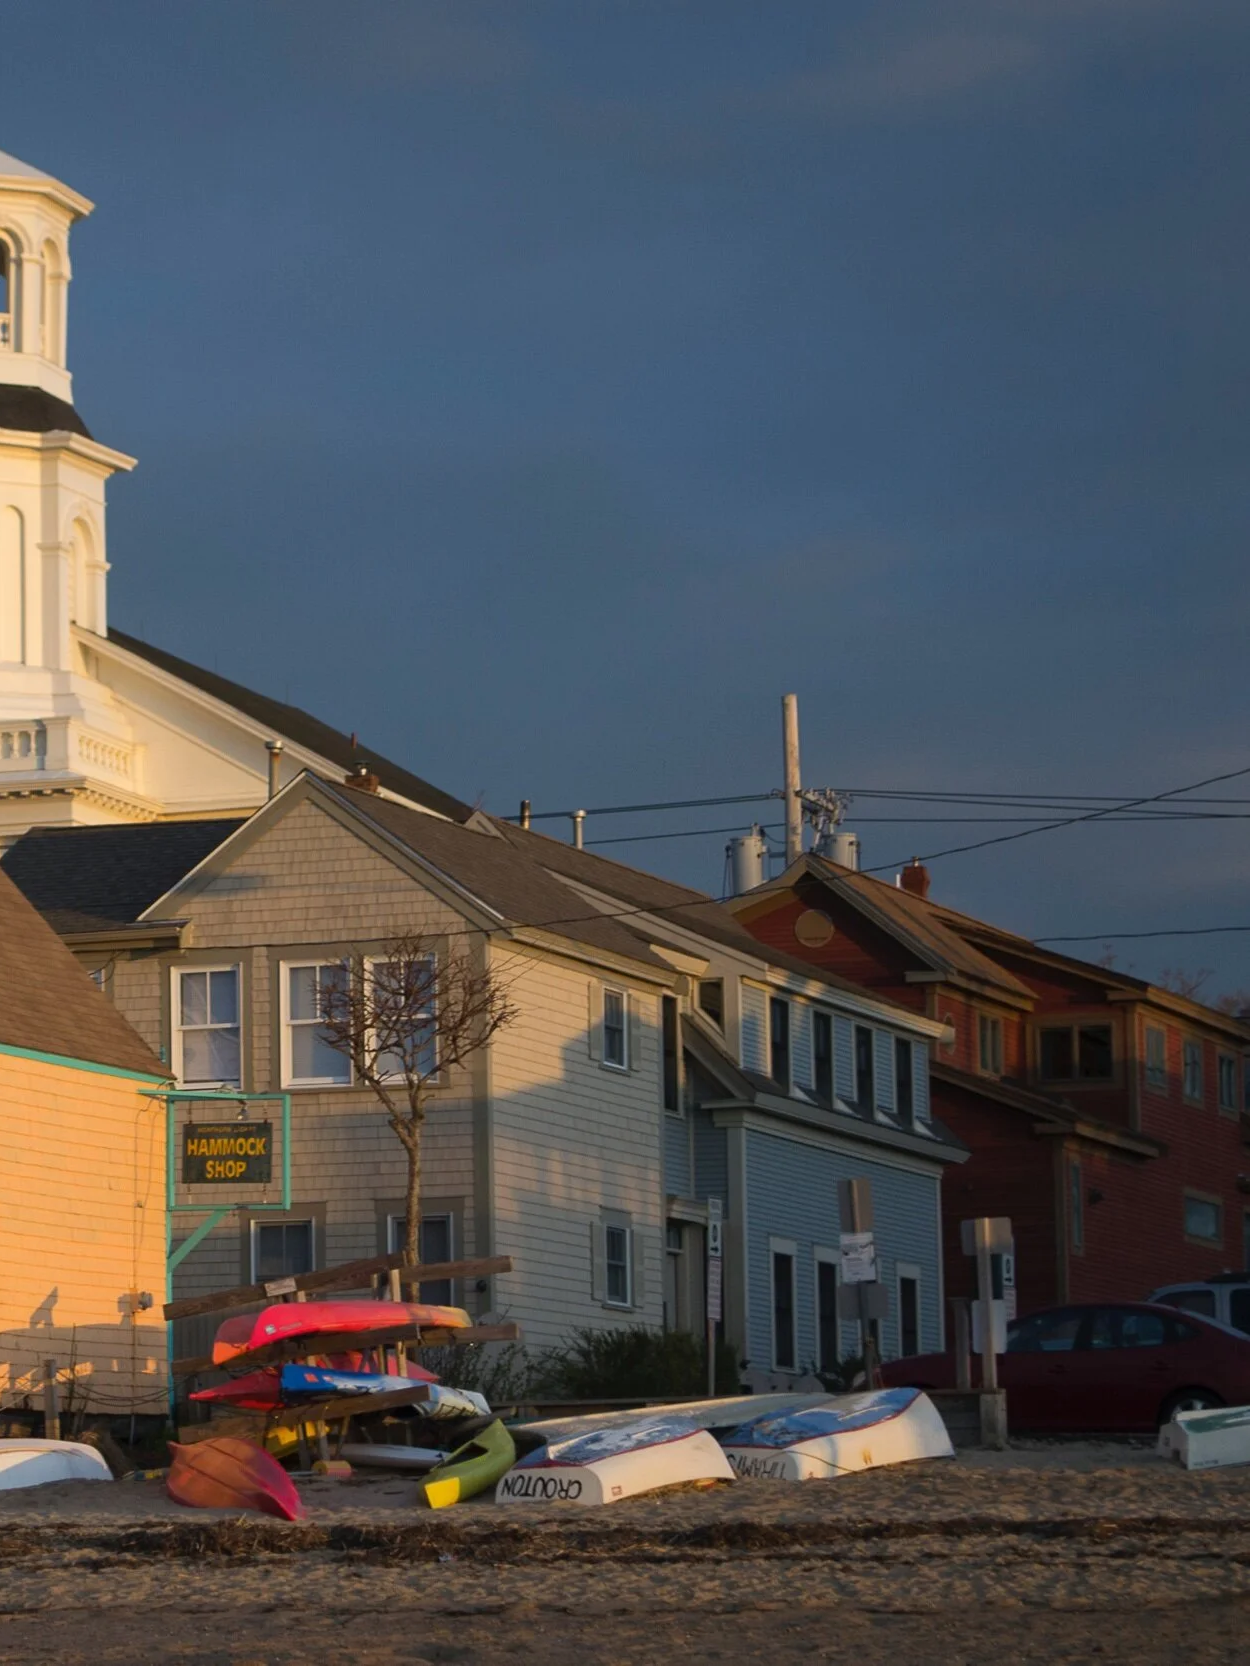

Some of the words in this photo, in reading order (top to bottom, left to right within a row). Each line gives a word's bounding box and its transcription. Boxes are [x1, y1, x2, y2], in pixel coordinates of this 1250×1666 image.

[187, 1138, 266, 1156] HAMMOCK
[205, 1160, 247, 1178] SHOP
[501, 1474, 583, 1500] CROUTON
